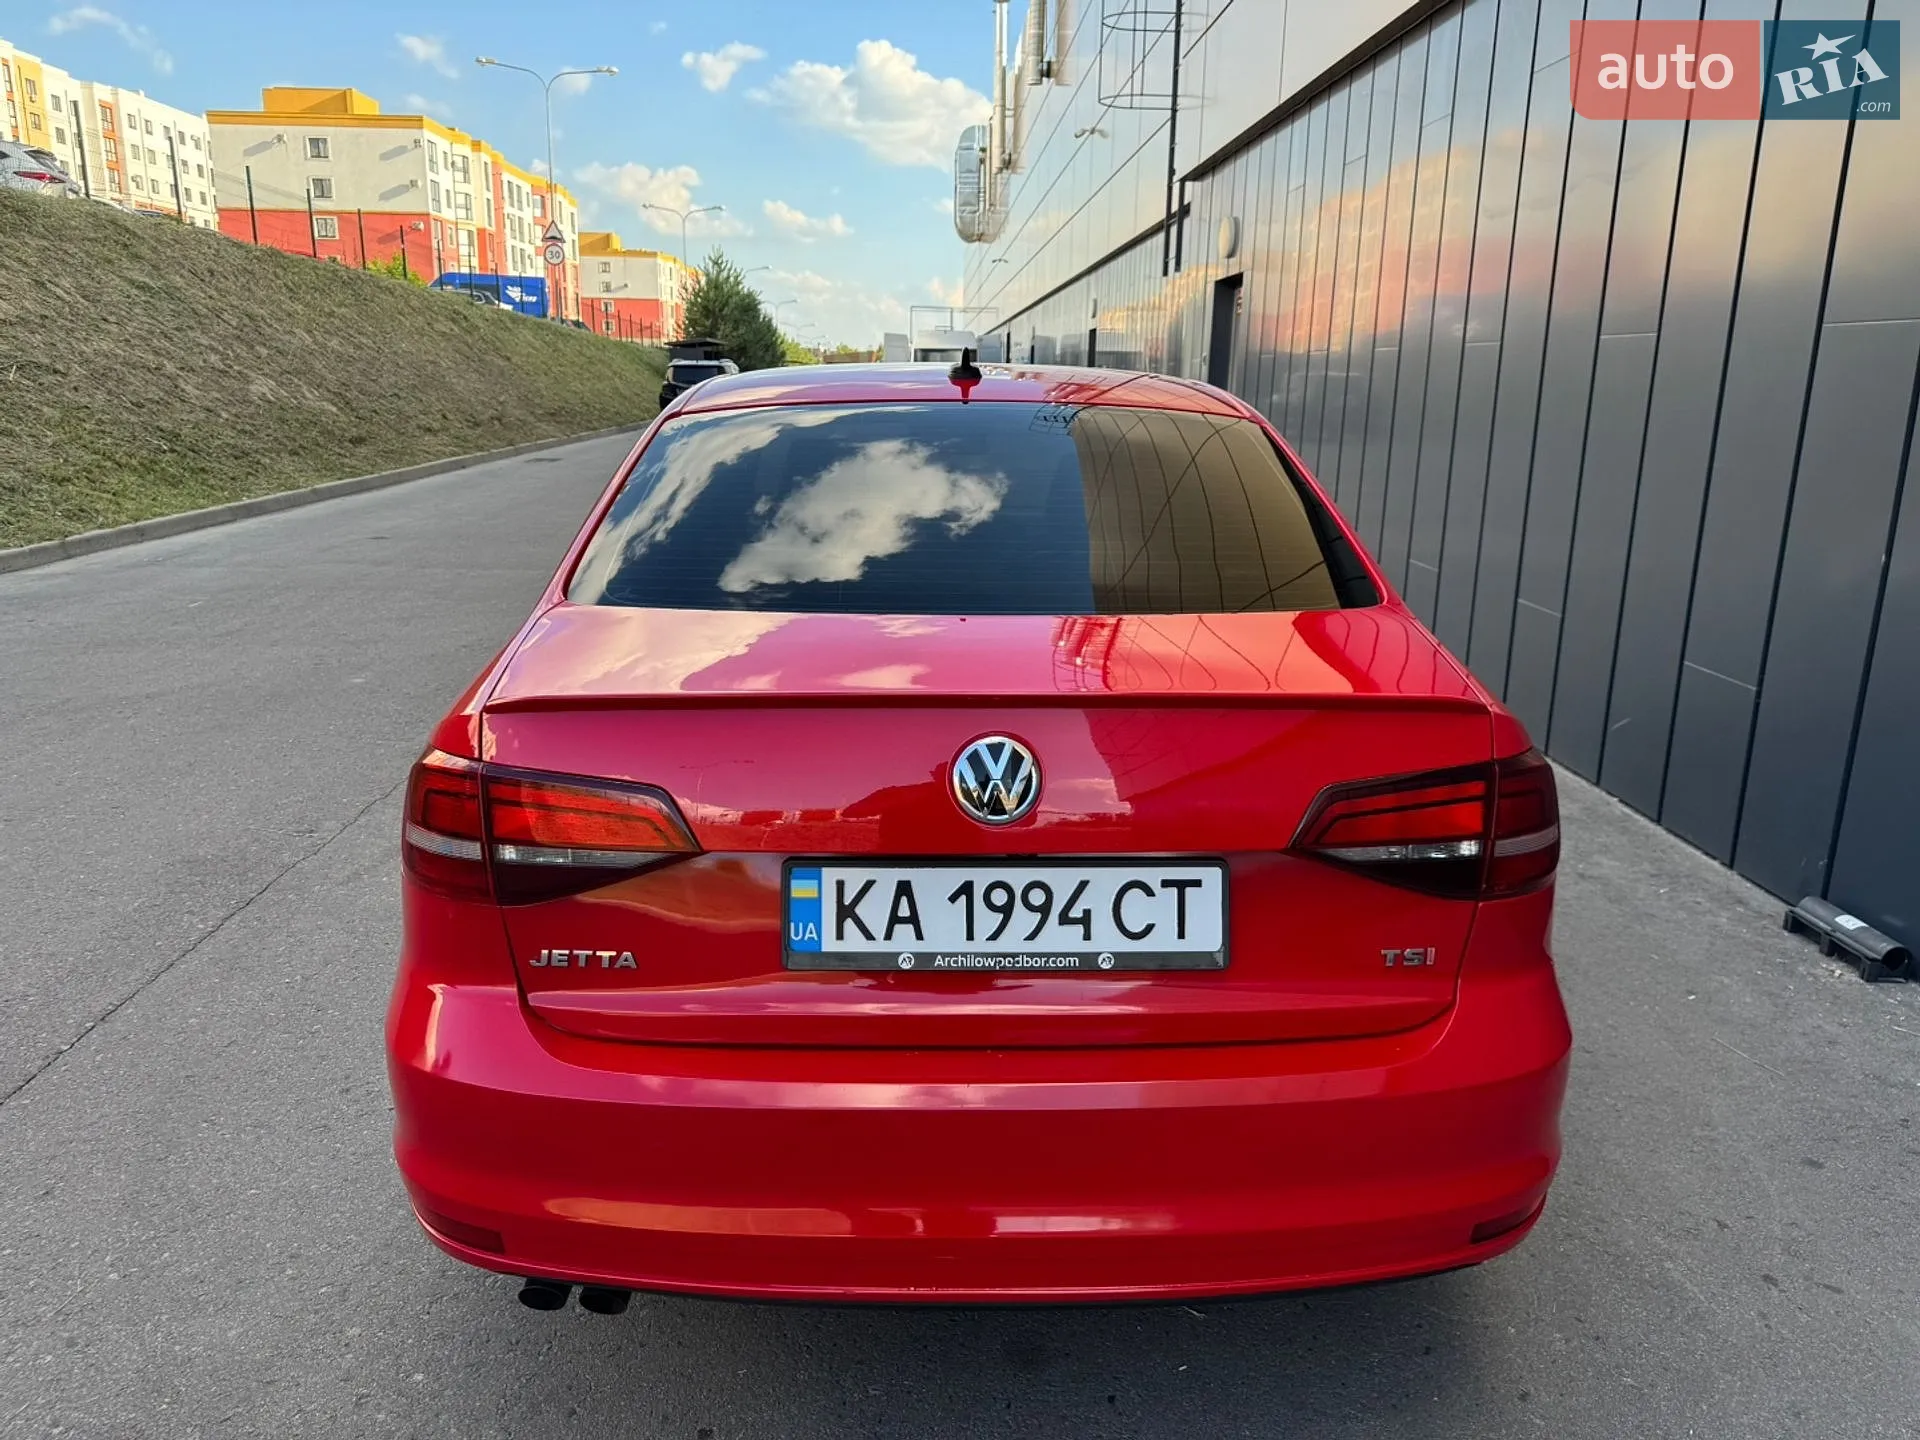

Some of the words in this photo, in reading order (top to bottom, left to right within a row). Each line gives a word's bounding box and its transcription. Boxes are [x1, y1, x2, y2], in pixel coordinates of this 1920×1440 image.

[548, 251, 560, 259] 30
[835, 879, 924, 941] KA
[947, 879, 1092, 941] 1994
[1112, 879, 1203, 941] CT
[790, 922, 819, 941] UA
[529, 949, 637, 968] JETTA
[1380, 947, 1436, 967] TSI
